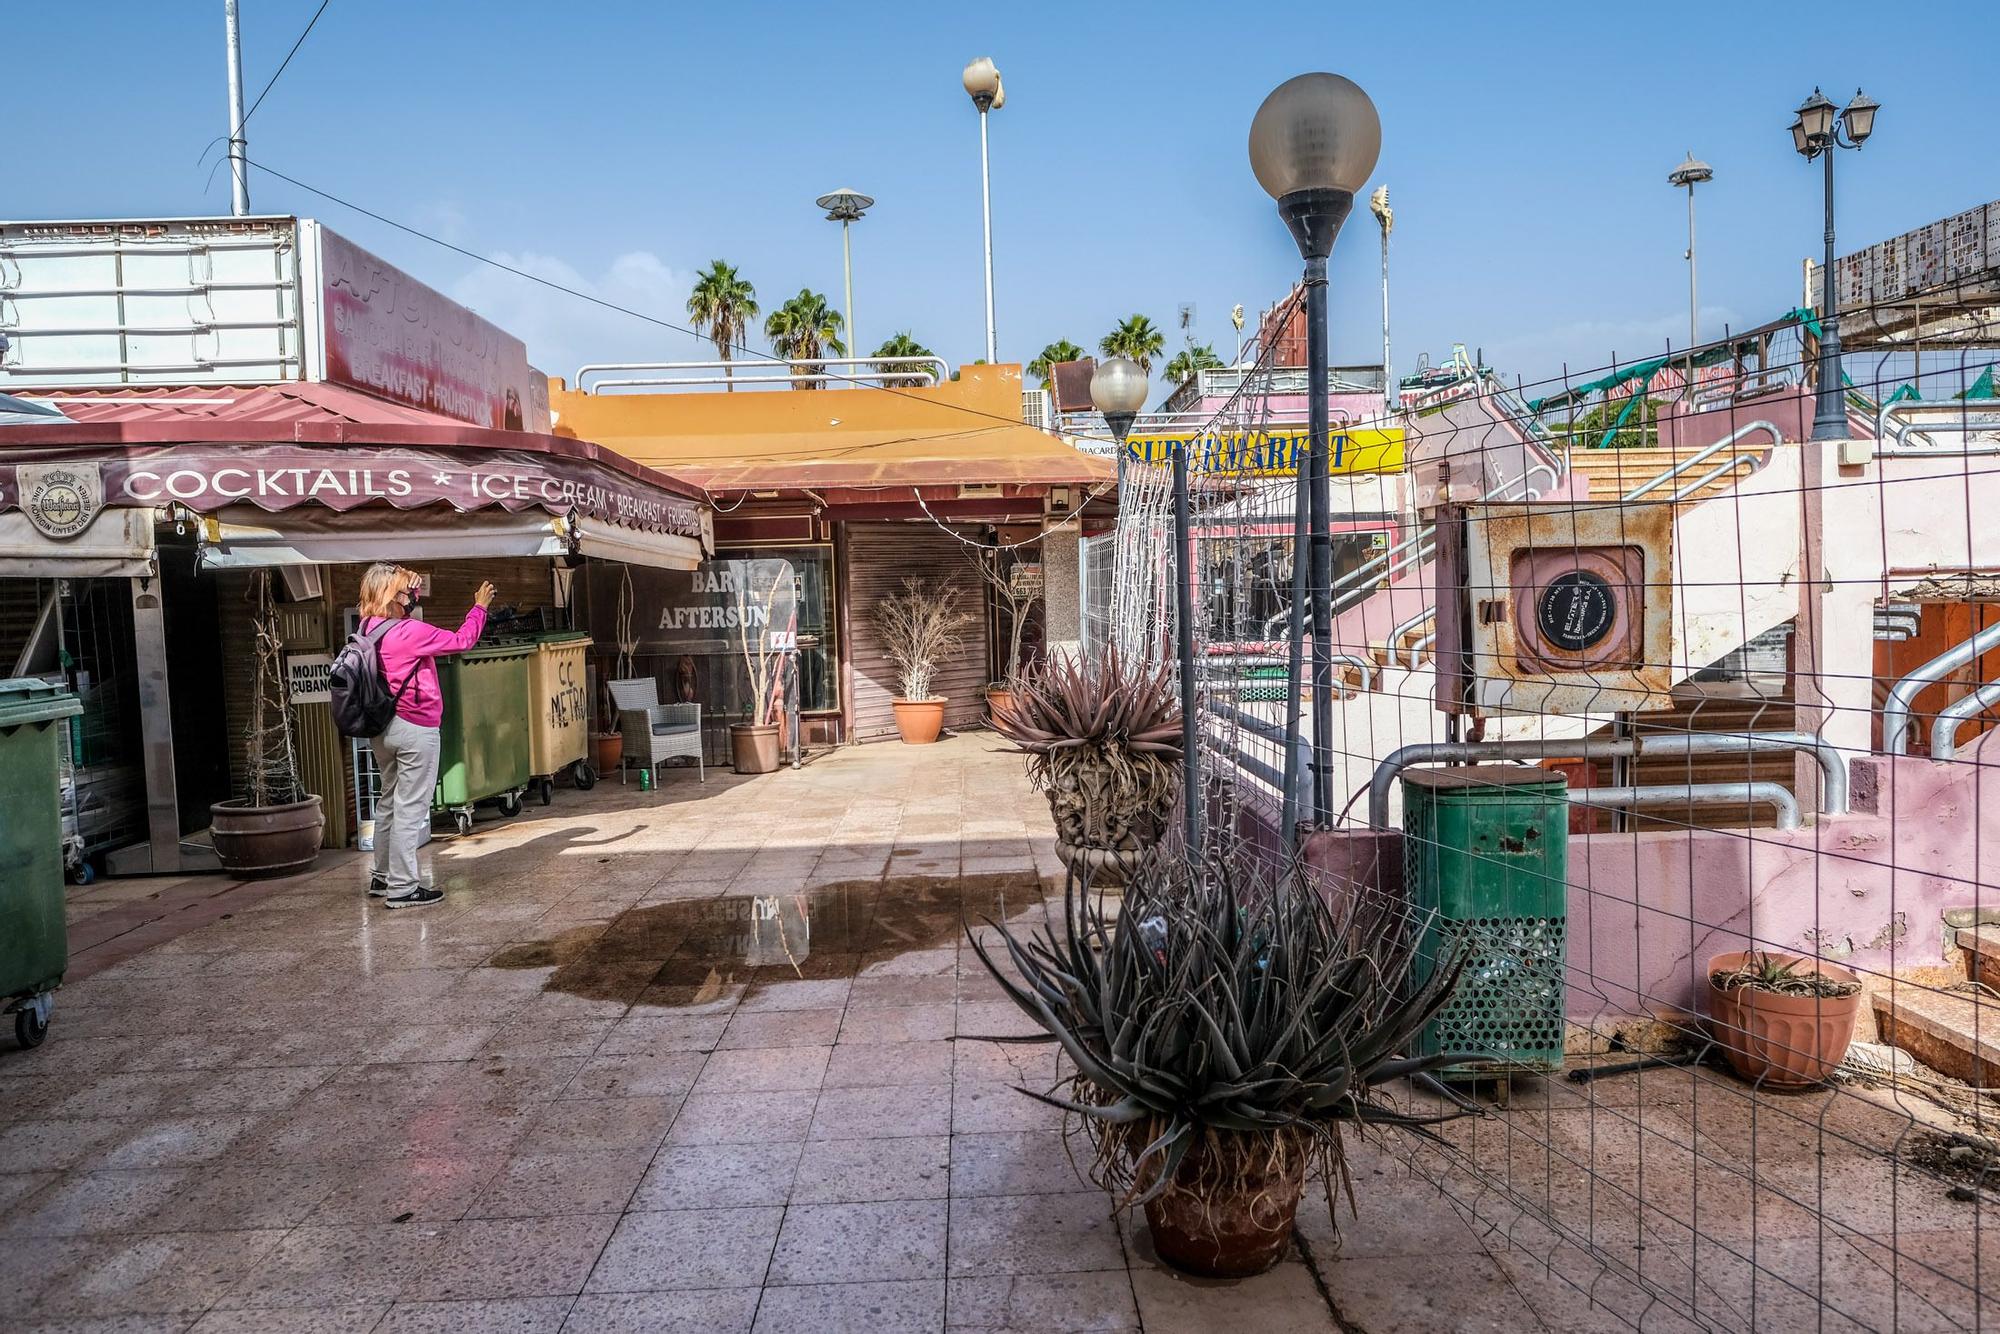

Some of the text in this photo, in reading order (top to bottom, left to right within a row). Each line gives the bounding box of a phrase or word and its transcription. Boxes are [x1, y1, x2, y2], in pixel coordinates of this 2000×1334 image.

[352, 356, 429, 402] BREAKFAST
[1127, 435, 1349, 471] SUPRMARKT
[123, 468, 412, 499] COCKTAILS
[471, 472, 530, 500] ICE
[541, 479, 608, 511] CREAM
[617, 494, 660, 522] BREAKFAST
[52, 525, 78, 535] UNTER
[79, 512, 91, 528] DEN
[691, 571, 735, 593] BAR
[658, 605, 770, 629] AFTERSUN
[292, 664, 331, 679] MOJITO
[551, 687, 586, 729] METRO
